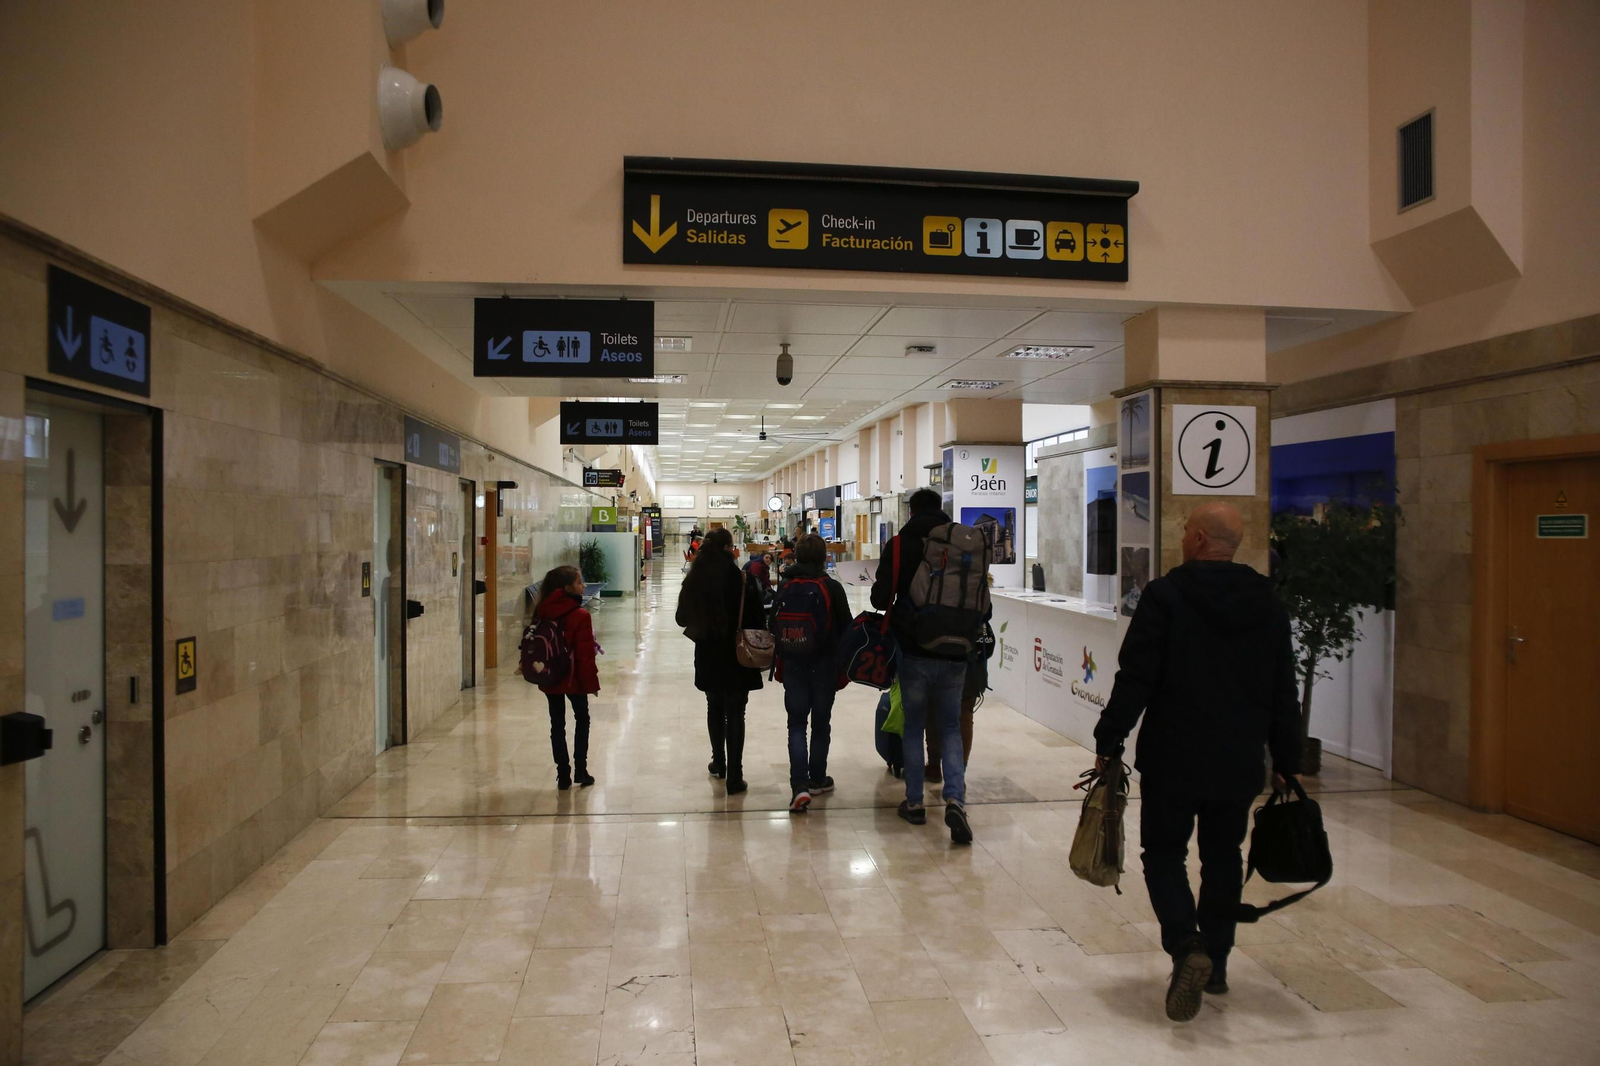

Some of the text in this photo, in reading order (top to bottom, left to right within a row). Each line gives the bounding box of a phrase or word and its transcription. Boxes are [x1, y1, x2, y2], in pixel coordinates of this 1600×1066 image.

[687, 208, 757, 226] Departures
[821, 214, 876, 231] Check-in
[686, 229, 747, 245] Salidas
[822, 233, 914, 252] Facturación
[600, 332, 638, 345] Toilets
[600, 348, 643, 362] Aseos
[628, 419, 650, 428] Toilets
[628, 428, 652, 437] Aseos
[970, 475, 1006, 491] Jaén
[1071, 680, 1106, 709] Granada
